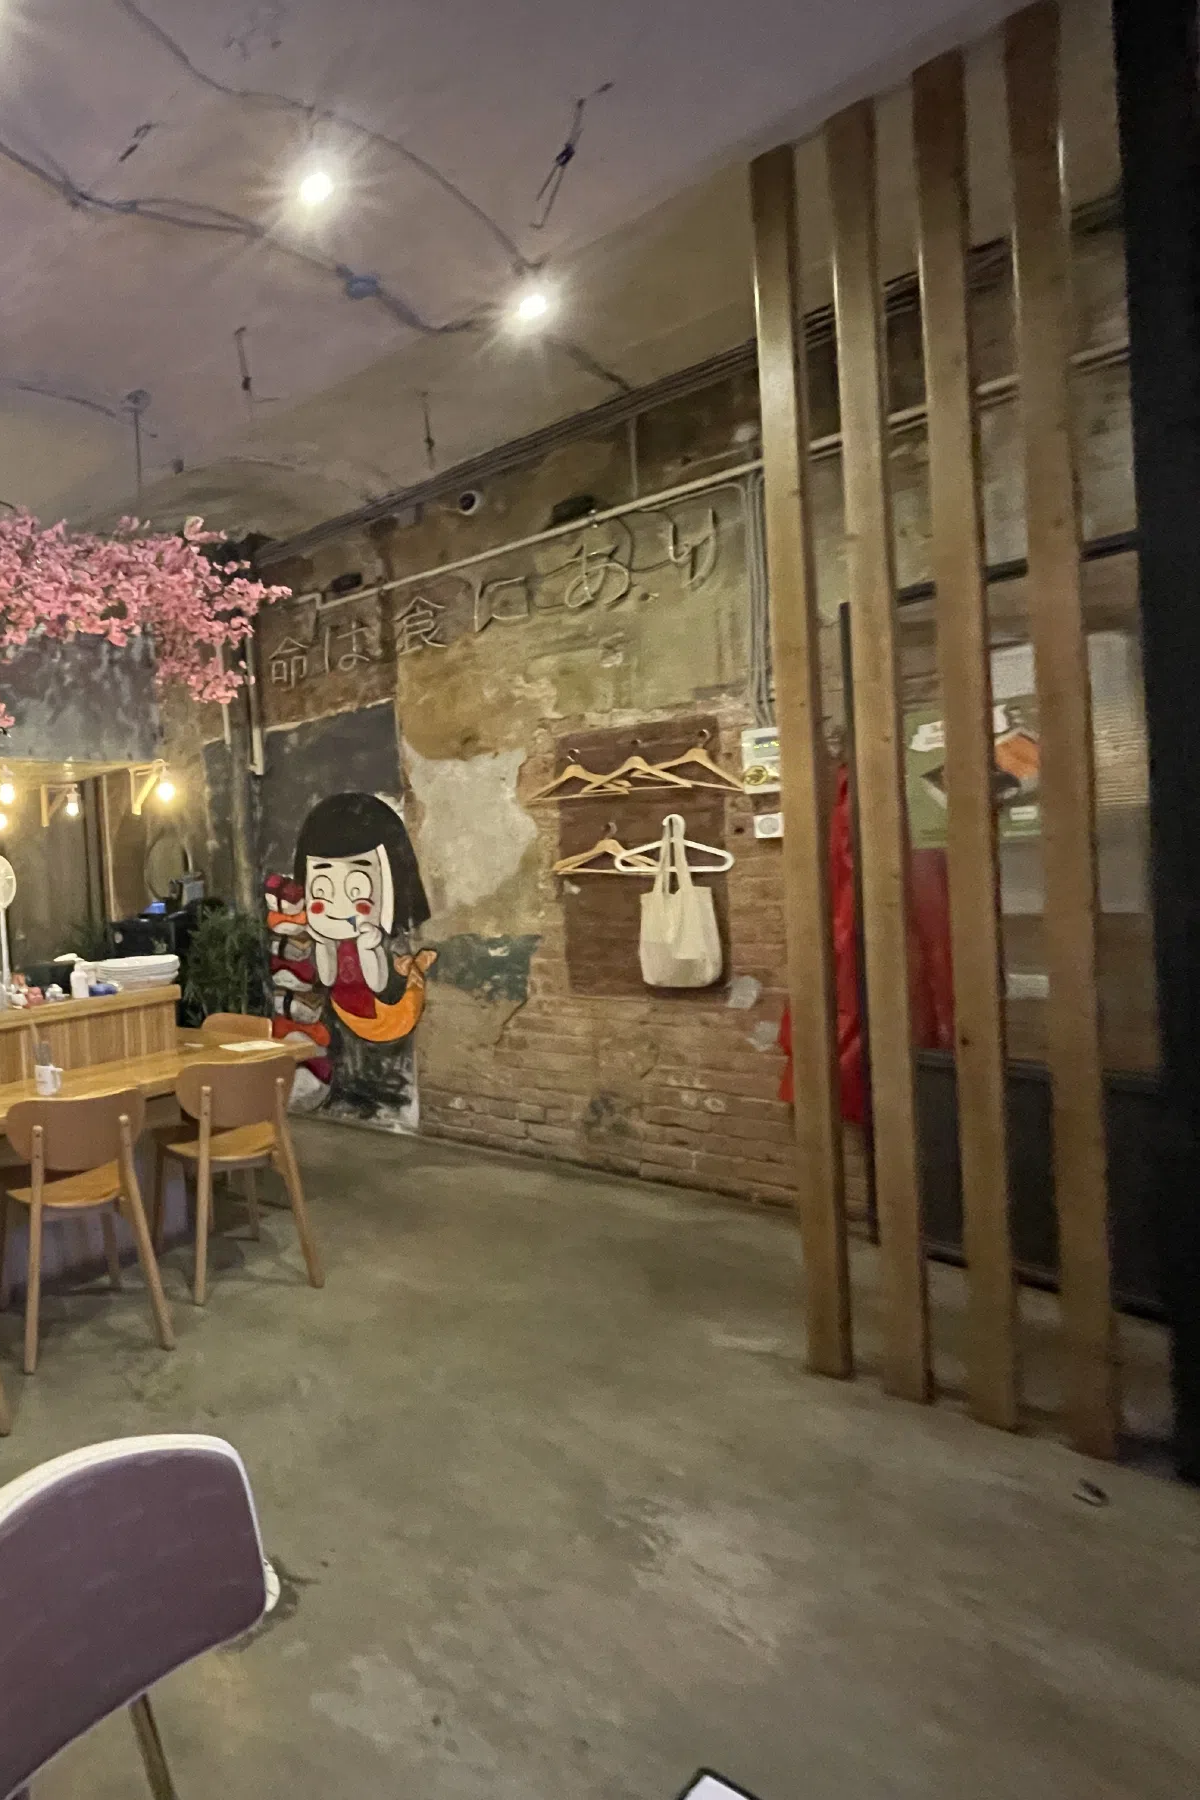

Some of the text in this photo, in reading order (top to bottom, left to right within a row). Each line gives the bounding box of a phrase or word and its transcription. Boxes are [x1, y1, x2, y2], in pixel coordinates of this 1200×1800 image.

[269, 508, 716, 689] 命は食にあり
